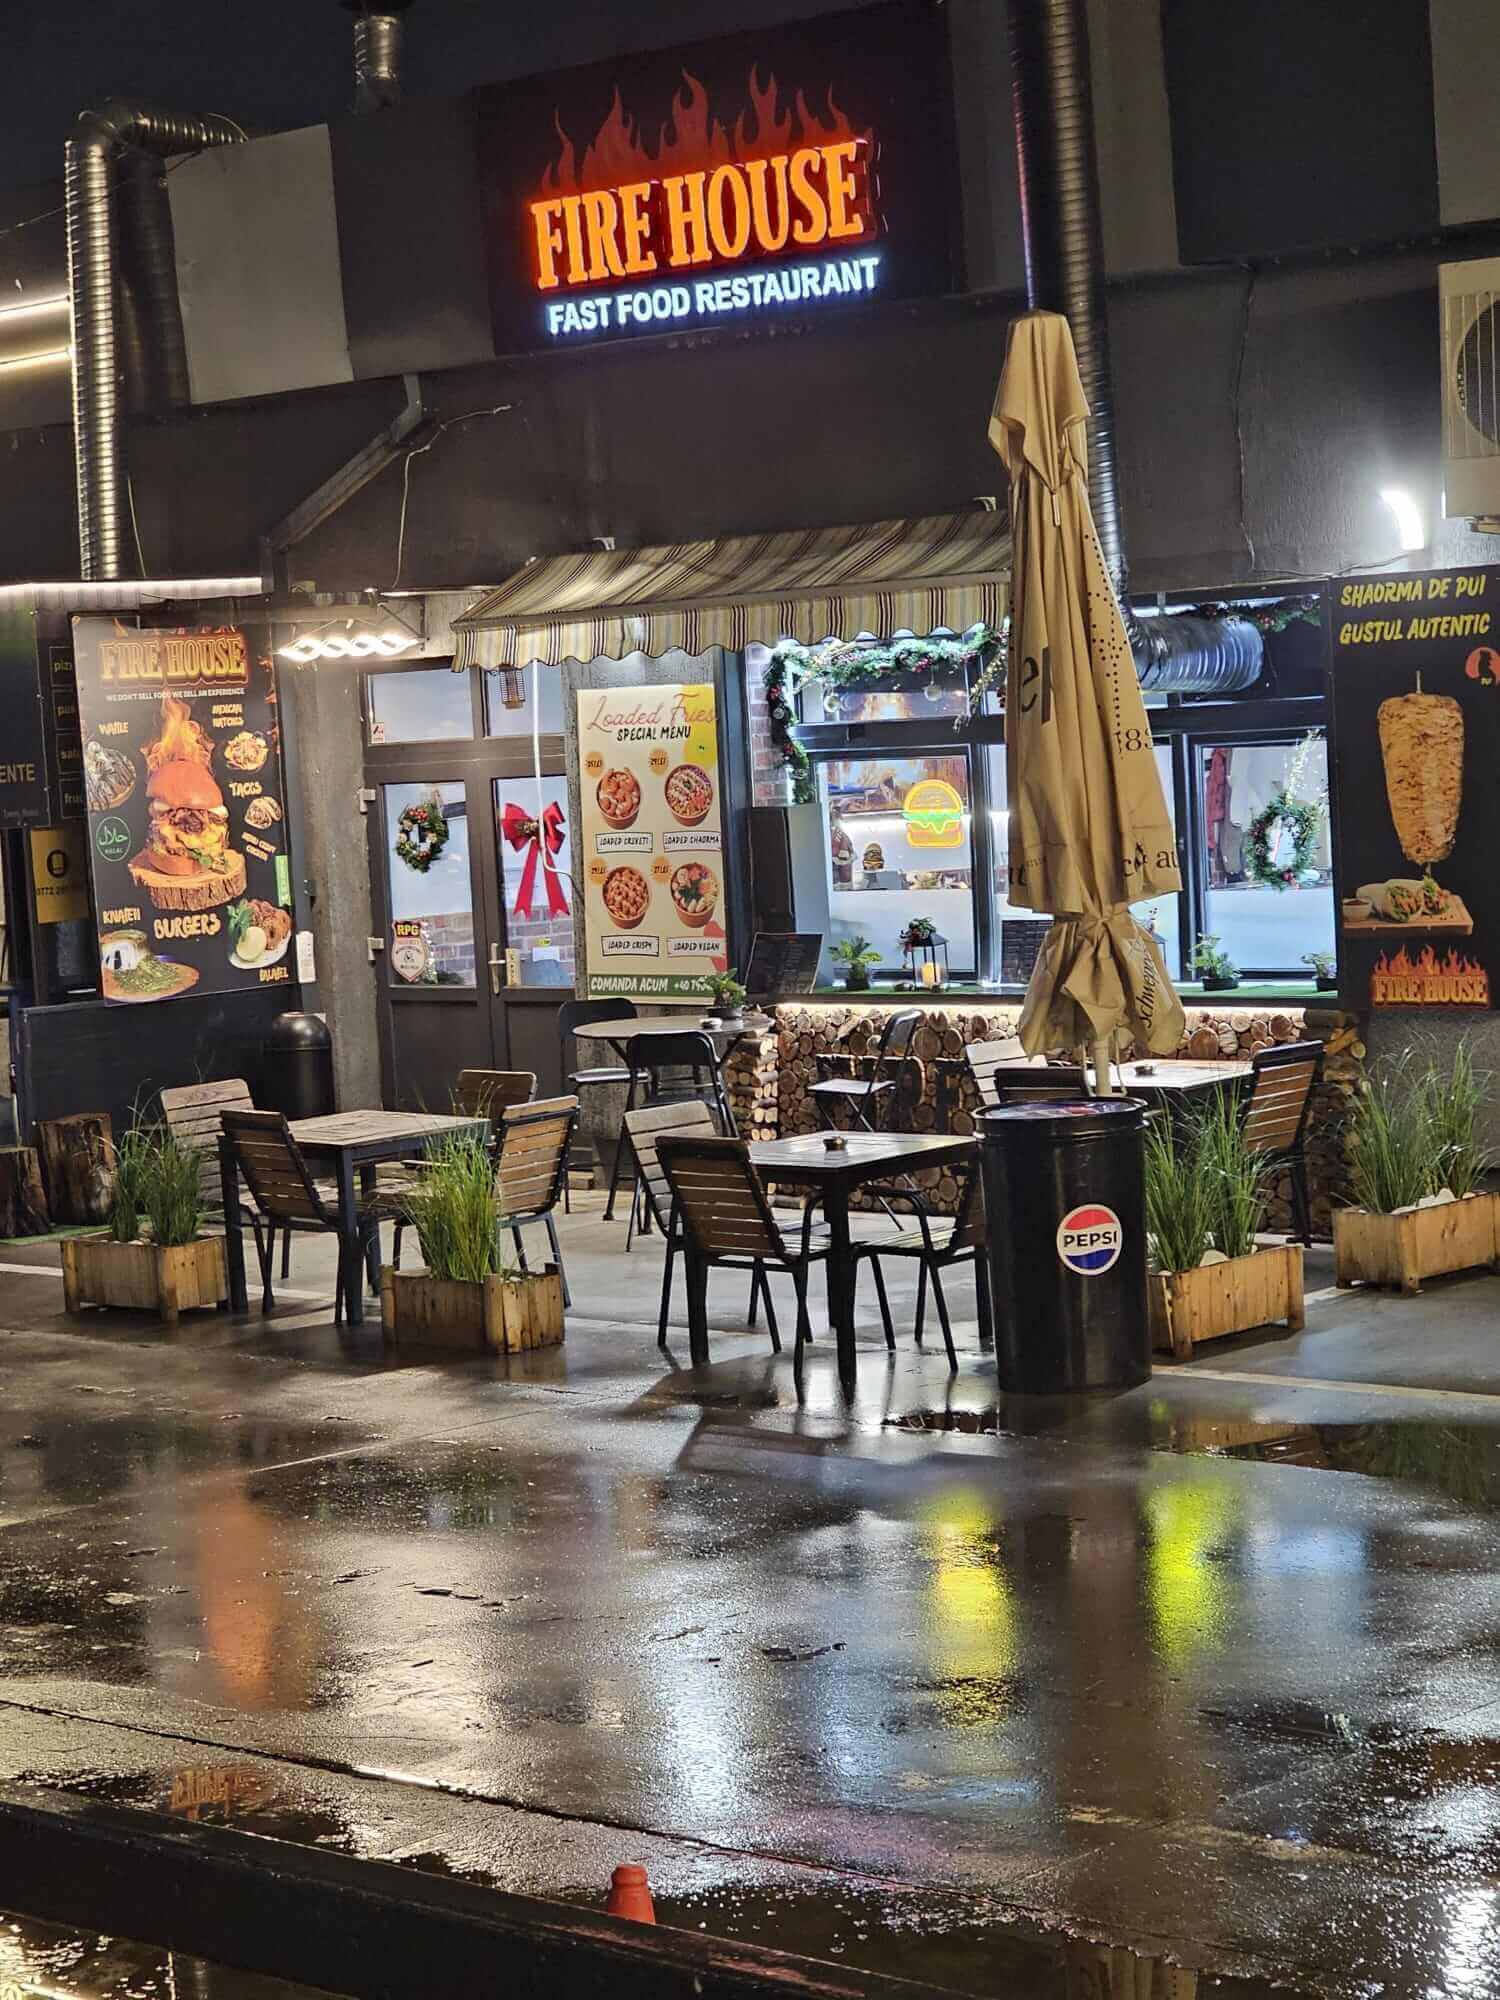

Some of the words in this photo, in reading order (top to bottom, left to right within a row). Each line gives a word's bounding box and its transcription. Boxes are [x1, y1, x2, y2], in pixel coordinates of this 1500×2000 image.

[530, 182, 658, 289] FIRE
[663, 141, 864, 267] HOUSE
[547, 297, 613, 335] FAST
[617, 286, 691, 324] FOOD
[694, 257, 881, 315] RESTAURANT
[1340, 580, 1423, 608] SHAORMA
[1428, 577, 1452, 599] DE
[1455, 574, 1486, 598] PUI
[1339, 619, 1403, 645] GUSTUL
[1406, 613, 1491, 640] AUTENTIC
[99, 640, 163, 680] FIRE
[164, 637, 246, 679] HOUSE
[587, 695, 664, 732] Loaded
[670, 692, 719, 727] Fries
[616, 727, 656, 742] SPECIAL
[660, 725, 691, 740] MENU
[153, 913, 221, 939] BURGERS
[396, 924, 419, 937] RPG
[590, 976, 637, 991] COMANDA
[639, 977, 669, 992] ACUM
[1374, 975, 1421, 1004] FIRE
[1423, 975, 1488, 1005] HOUSE
[1063, 1230, 1118, 1248] PEPSI
